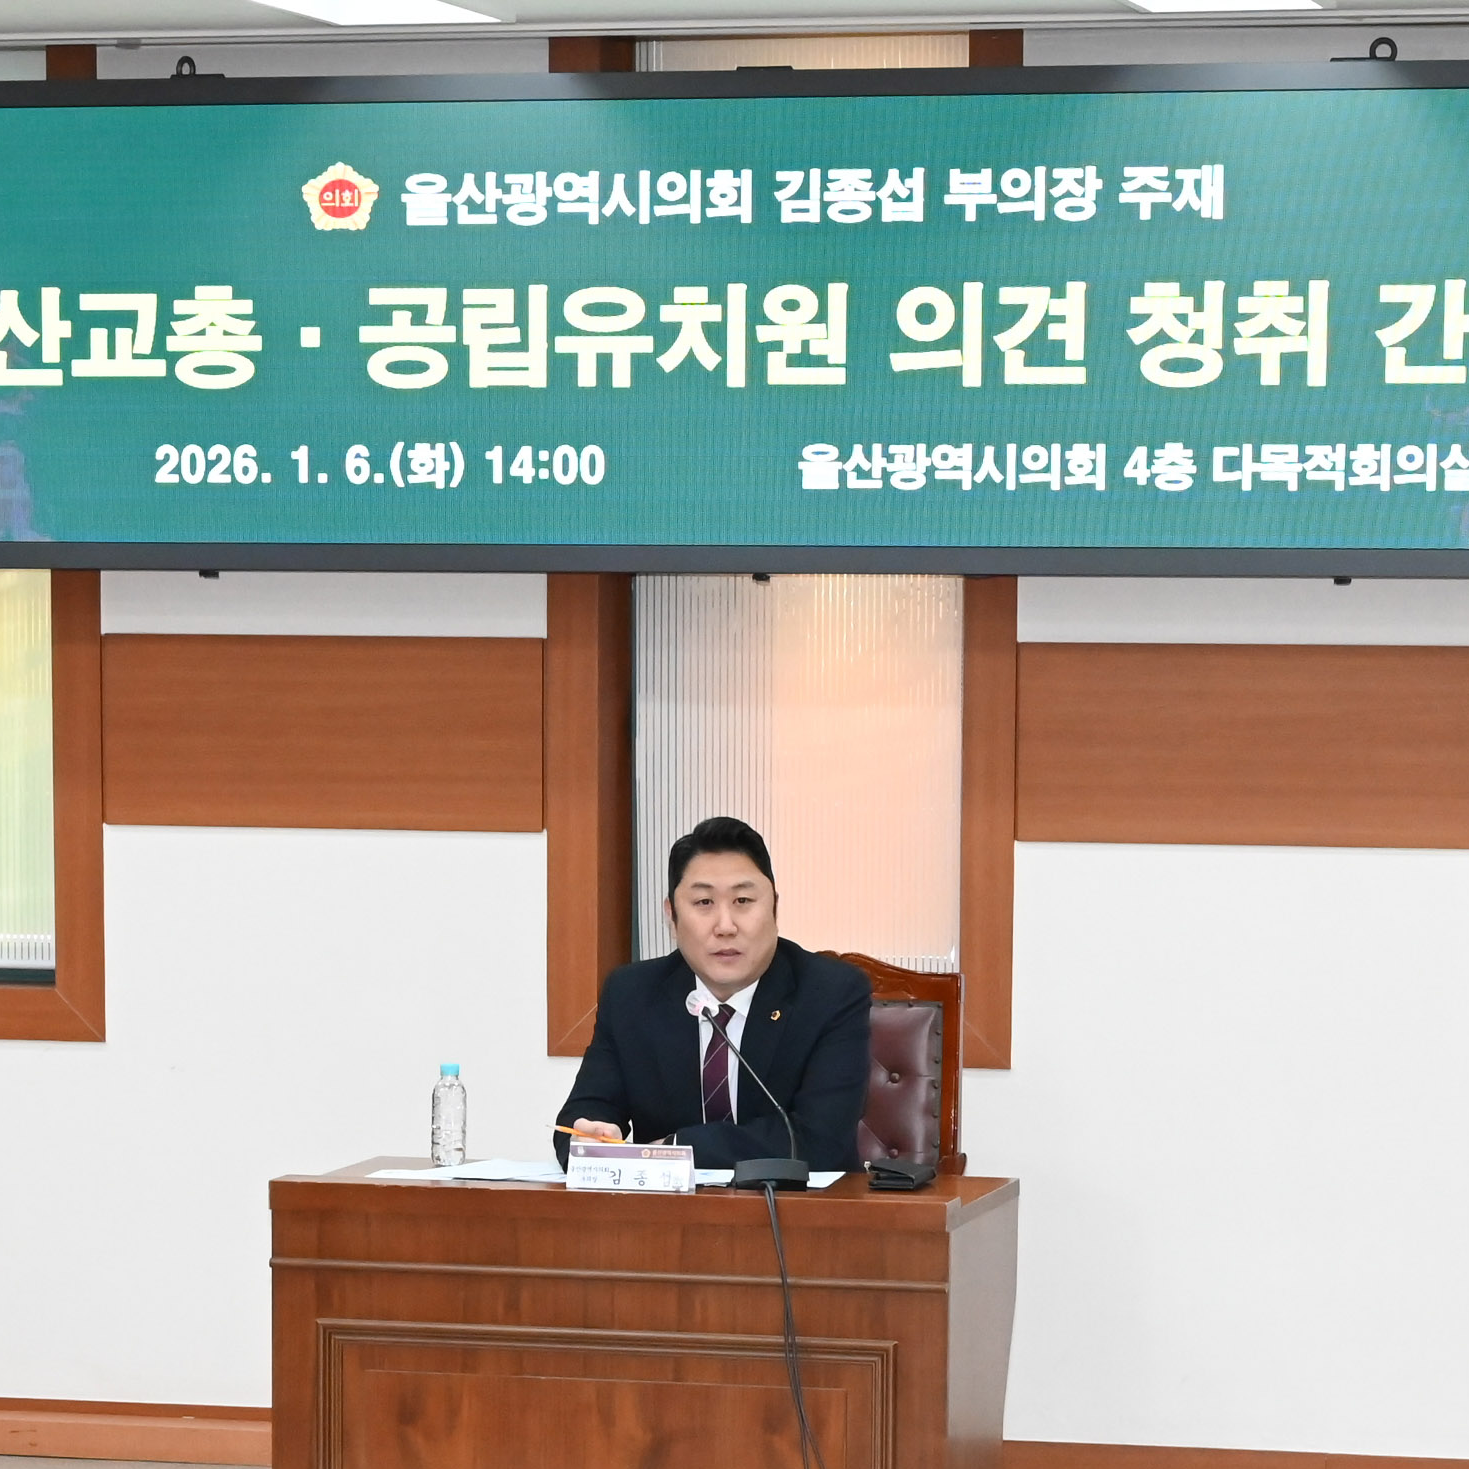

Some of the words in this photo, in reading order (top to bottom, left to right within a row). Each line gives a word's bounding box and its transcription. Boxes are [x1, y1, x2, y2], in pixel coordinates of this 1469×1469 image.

[321, 189, 359, 207] 의회
[402, 170, 752, 226] 울산광역시의회
[775, 168, 924, 223] 김종섭
[945, 166, 1102, 221] 부의장
[1119, 165, 1223, 220] 주재
[360, 283, 848, 388] 공립유치원
[890, 282, 1086, 387] 의견
[1127, 280, 1329, 387] 청취
[156, 445, 271, 484] 2026.
[291, 446, 328, 484] 1.
[346, 442, 464, 488] 6.(화)
[486, 445, 604, 484] 14:00
[799, 444, 1105, 490] 울산광역시의회
[1124, 443, 1196, 491] 4층
[610, 1169, 621, 1185] 김
[634, 1169, 648, 1186] 종
